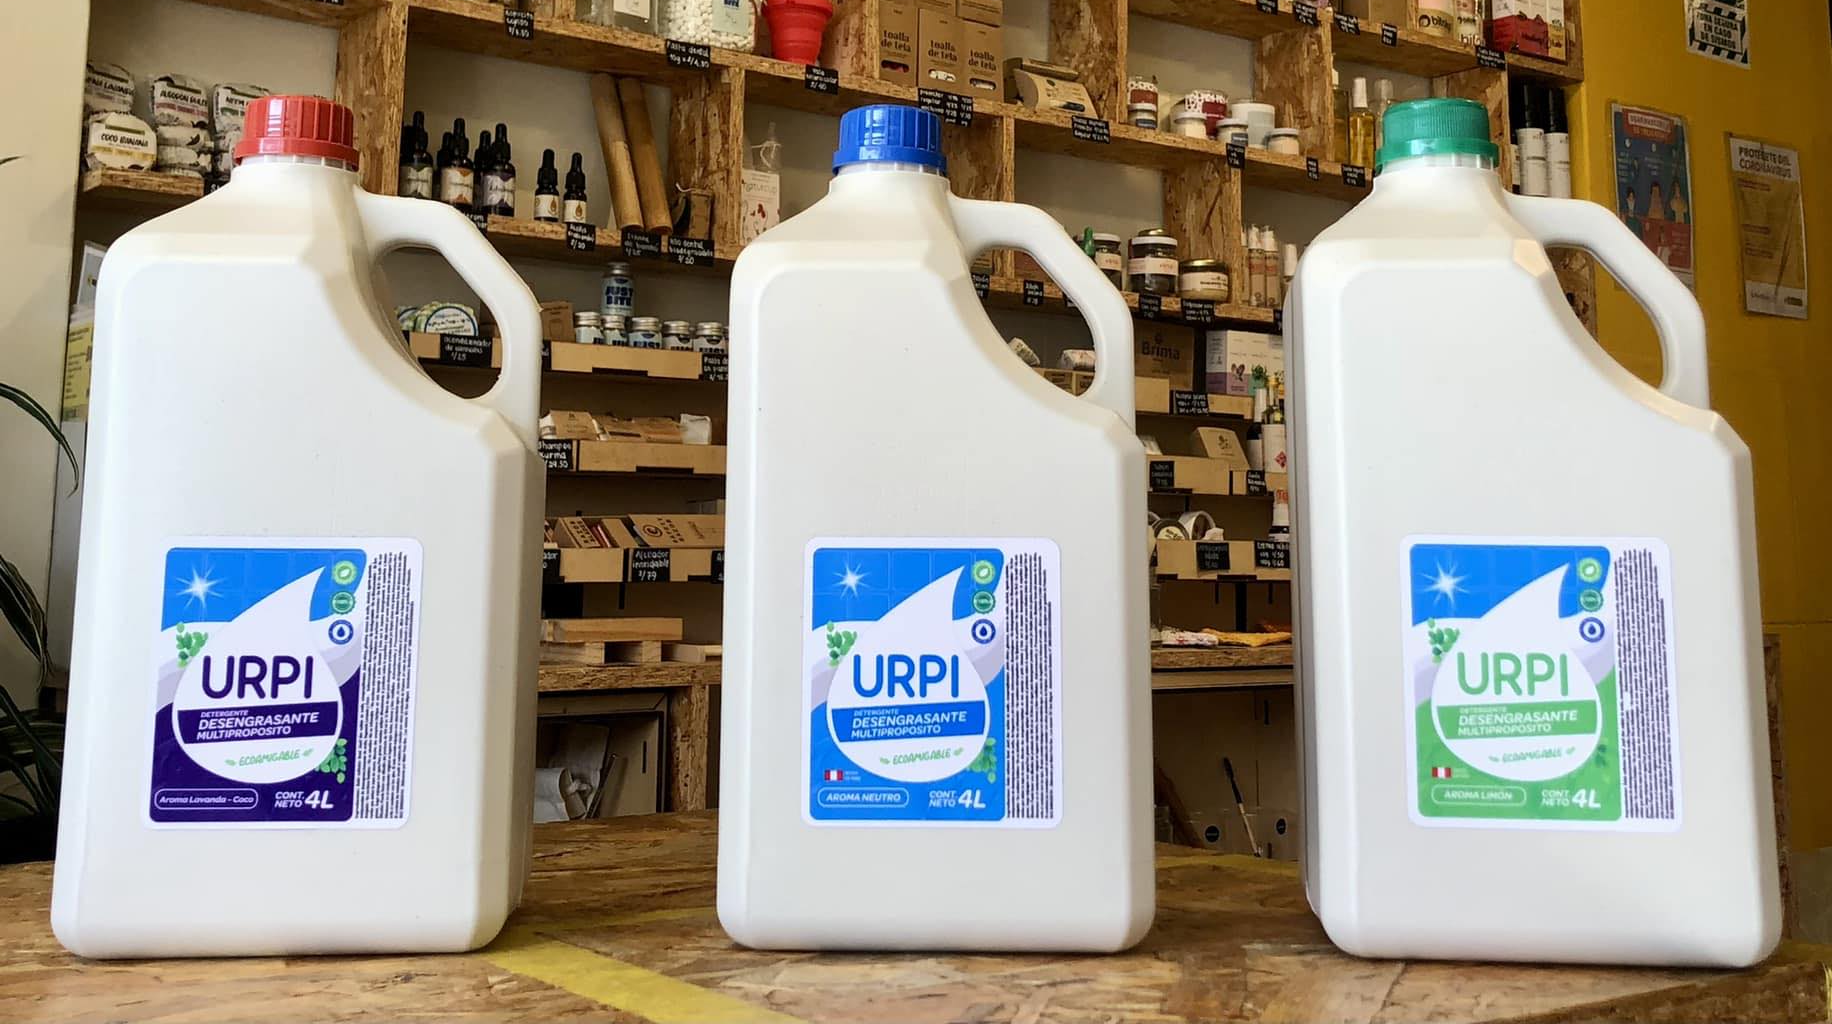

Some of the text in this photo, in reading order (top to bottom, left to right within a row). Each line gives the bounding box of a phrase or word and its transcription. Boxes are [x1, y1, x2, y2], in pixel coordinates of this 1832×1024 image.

[1714, 15, 1737, 30] SEGURA
[884, 29, 909, 43] toalla
[1704, 23, 1731, 39] EN CASO
[881, 38, 912, 53] de tela
[930, 39, 956, 52] toalla
[1701, 32, 1736, 49] DE SISMOS
[928, 48, 957, 62] de tela
[970, 49, 995, 62] toalla
[968, 57, 997, 72] de tela
[101, 133, 149, 147] COCO BANANA
[606, 286, 634, 297] JUST
[606, 296, 632, 307] BITE
[202, 655, 314, 699] URPI
[853, 654, 959, 698] URPI
[1456, 651, 1569, 696] URPI
[200, 709, 248, 718] DETERGENTE
[854, 708, 899, 717] DETERGENTE
[1459, 706, 1508, 714] DETERGENTE
[198, 712, 320, 731] DESENGRASANTE
[852, 711, 967, 729] DESENGRASANTE
[1458, 709, 1578, 727] DESENGRASANTE
[196, 726, 291, 741] MULTIPROPOSITO
[851, 724, 941, 739] MULTIPROPOSITO
[1457, 723, 1552, 737] MULTIPROPOSITO
[239, 750, 300, 766] ECOAMIGABLE
[893, 748, 951, 765] ECOAMIGABLE
[1502, 747, 1563, 763] ECOAMIGABLE
[159, 794, 188, 804] Aroma
[189, 794, 227, 804] Lavanda
[233, 794, 254, 804] Coco
[304, 790, 334, 809] 4L
[826, 793, 901, 802] AROMA NEUTRO
[958, 789, 986, 809] 4L
[1444, 791, 1479, 800] AROMA
[1541, 797, 1570, 806] NETO
[1571, 788, 1601, 808] 4L
[274, 799, 303, 808] NETO
[928, 799, 956, 808] NETO
